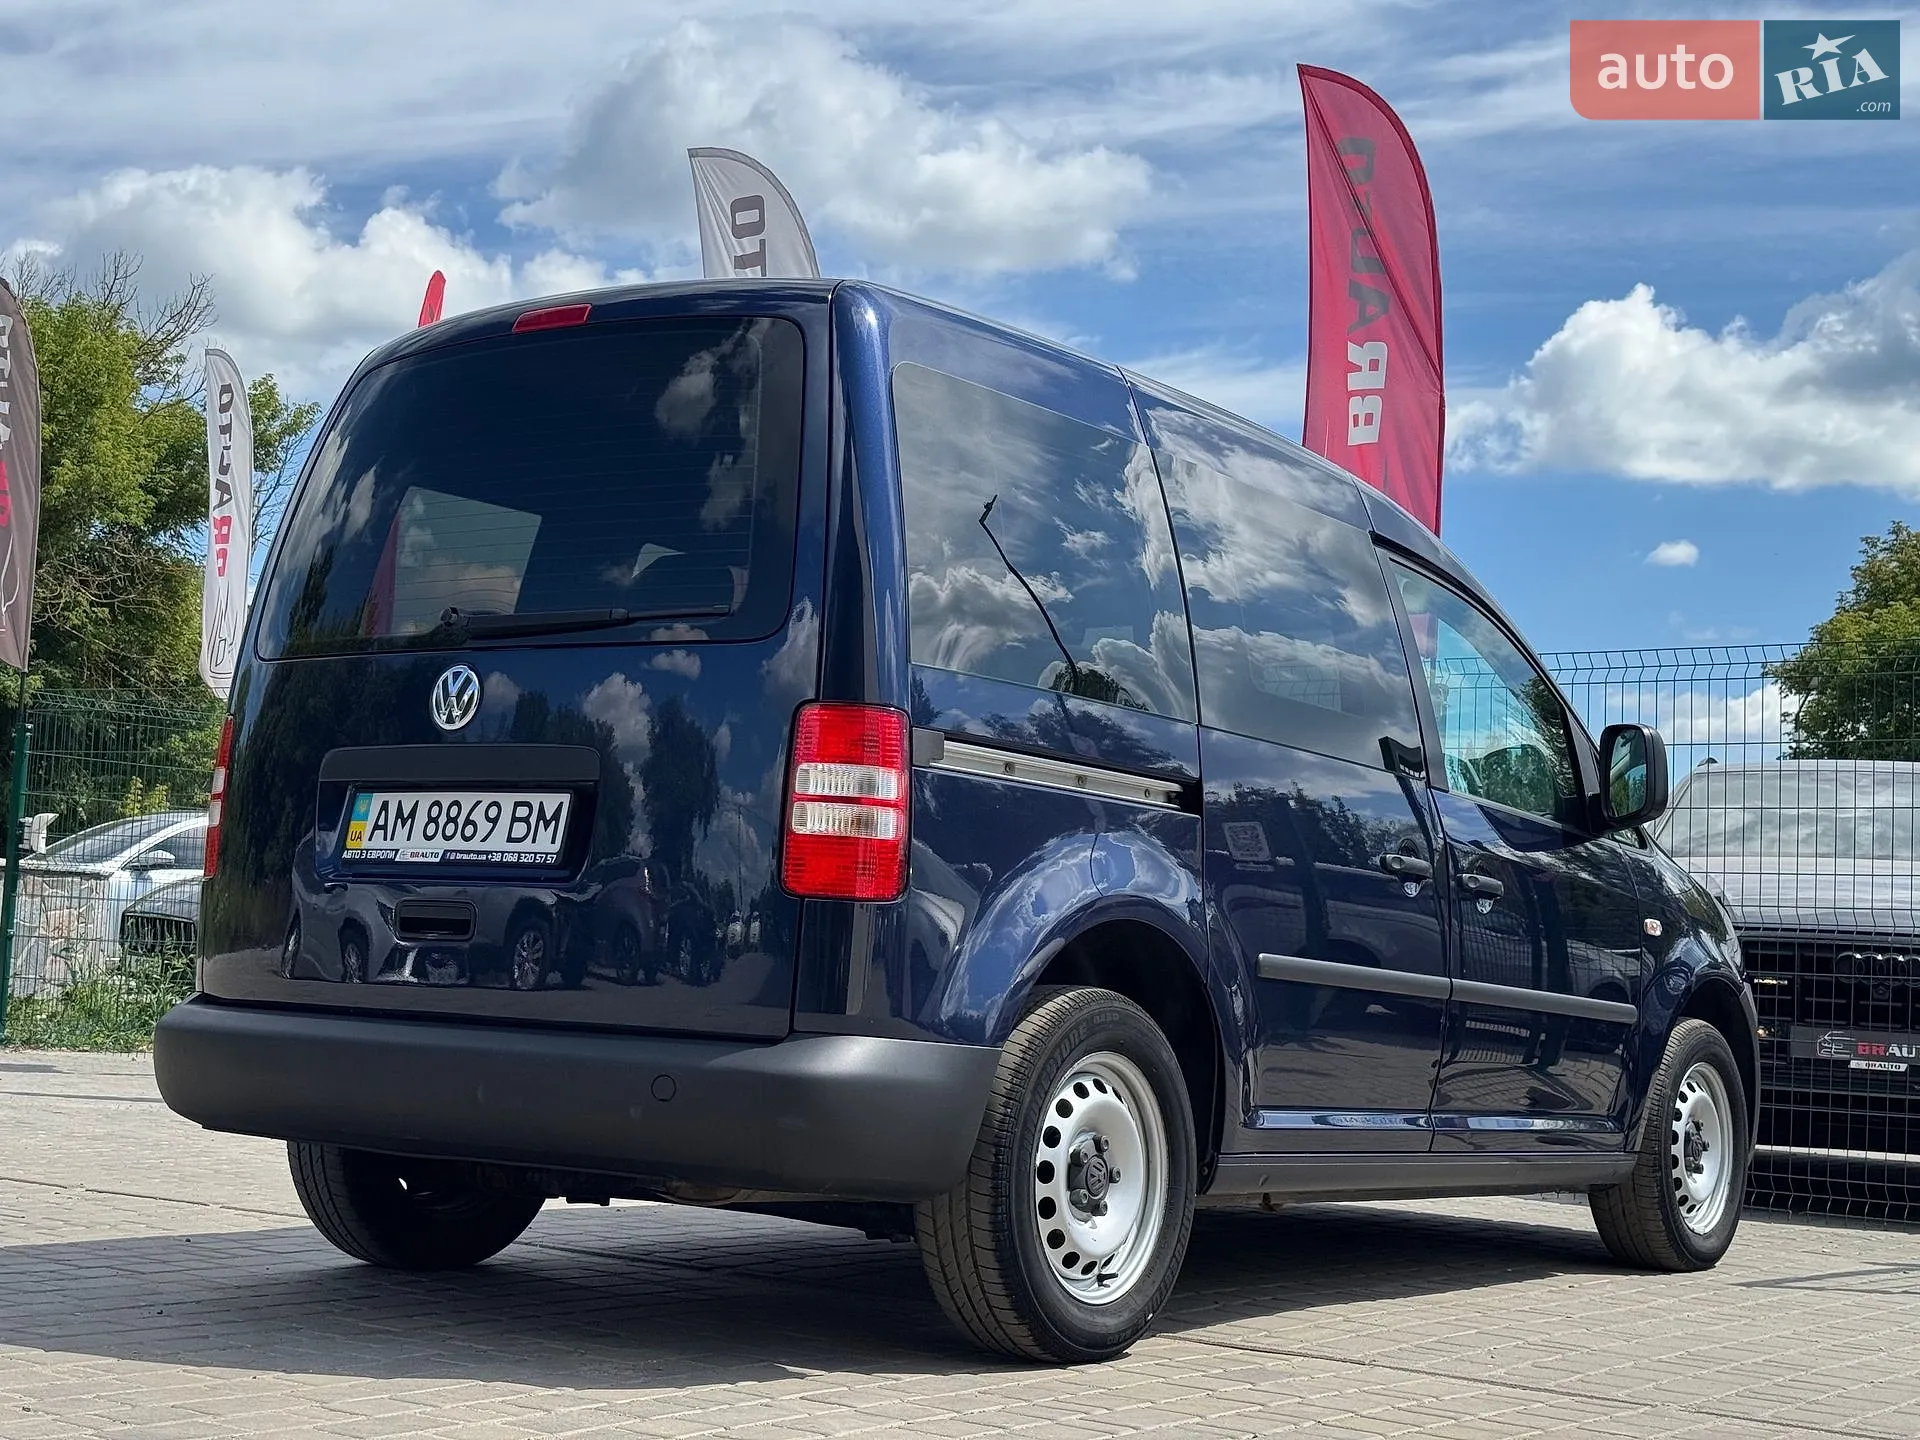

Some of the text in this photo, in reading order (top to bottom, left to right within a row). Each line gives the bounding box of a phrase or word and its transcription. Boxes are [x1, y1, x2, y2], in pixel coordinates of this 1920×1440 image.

[368, 799, 564, 845] AM 8869 BM
[350, 831, 362, 841] UA
[488, 853, 501, 862] +38
[503, 853, 518, 862] 068
[519, 854, 534, 863] 320
[535, 854, 546, 863] 57
[546, 855, 556, 864] 57
[1857, 1043, 1920, 1057] BRAU
